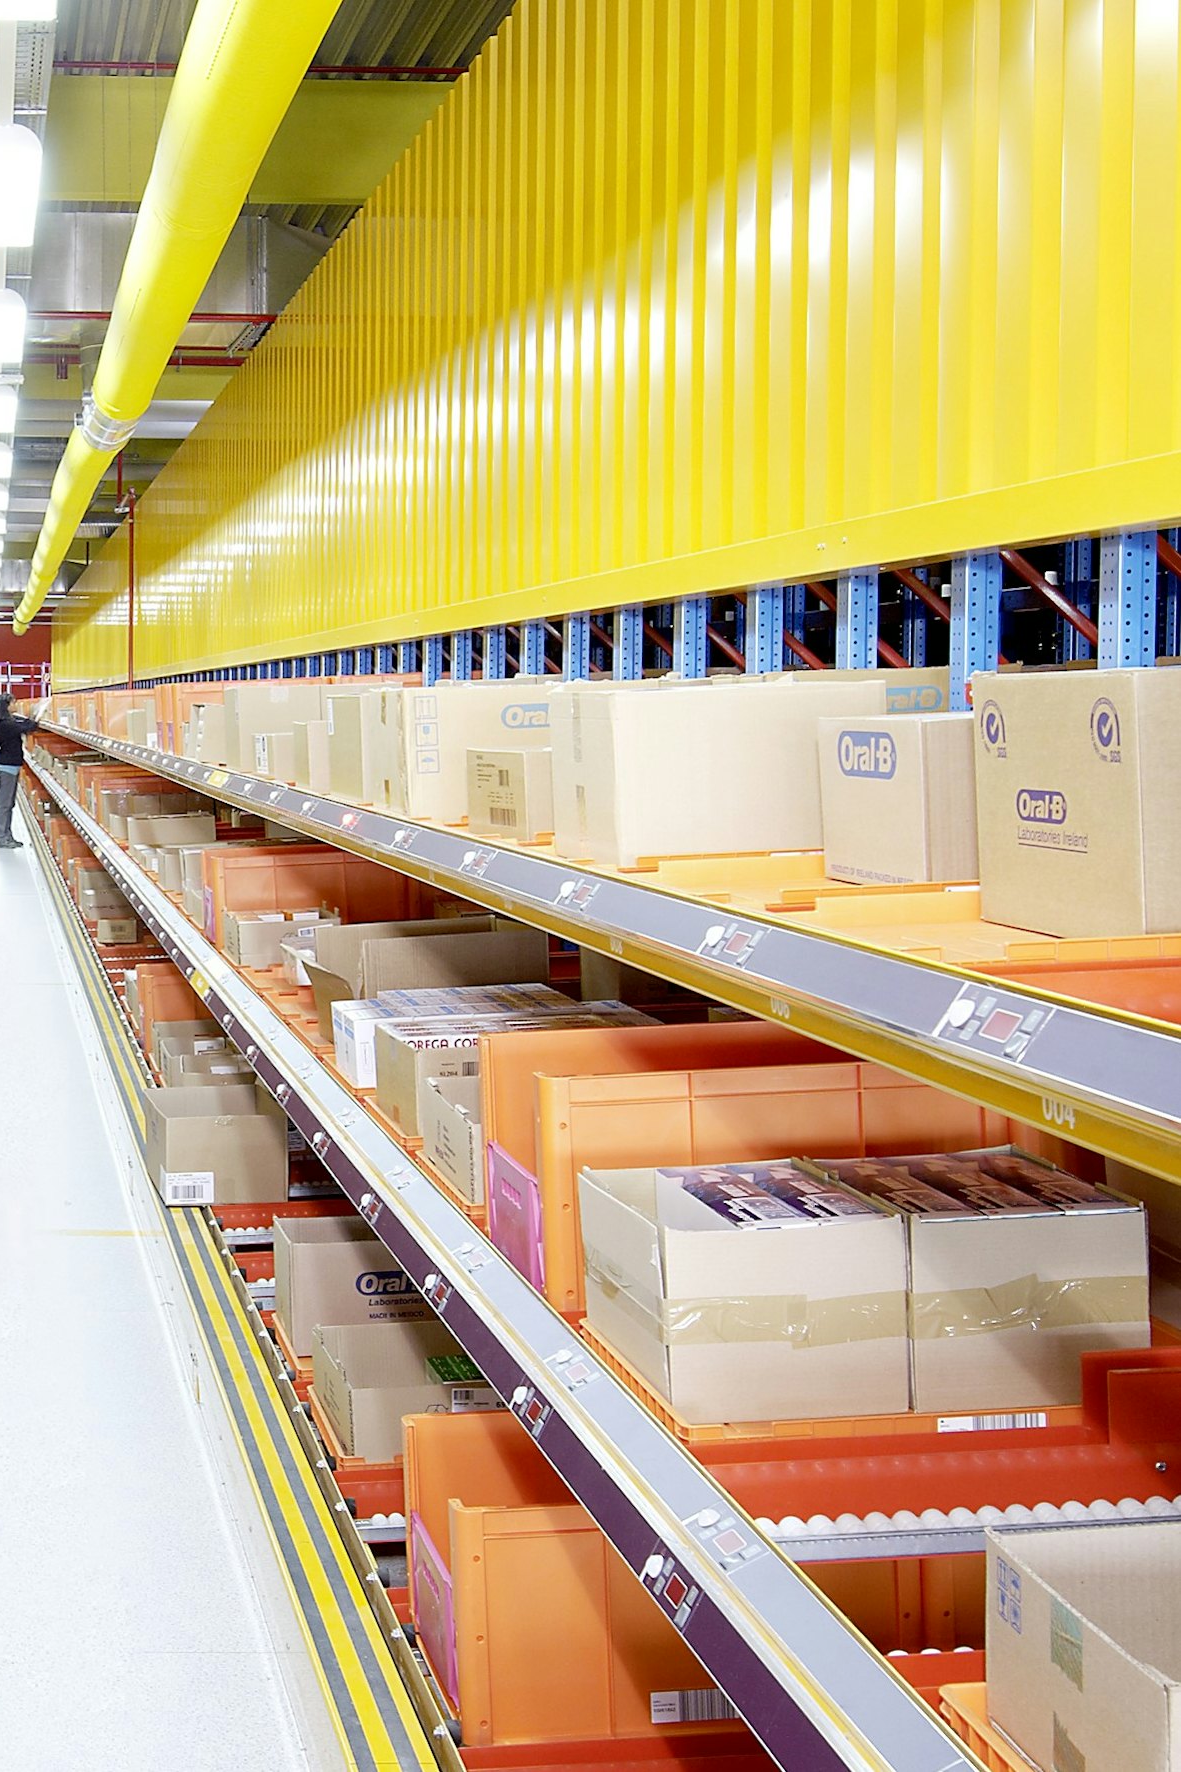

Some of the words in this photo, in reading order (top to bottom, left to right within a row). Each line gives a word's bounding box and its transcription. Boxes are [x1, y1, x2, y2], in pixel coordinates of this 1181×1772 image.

[840, 734, 893, 774] Oral-B
[1018, 791, 1064, 821] Oral-B
[1018, 826, 1061, 845] Laboratories
[1062, 831, 1088, 849] Ireland
[403, 1039, 449, 1050] OREGA
